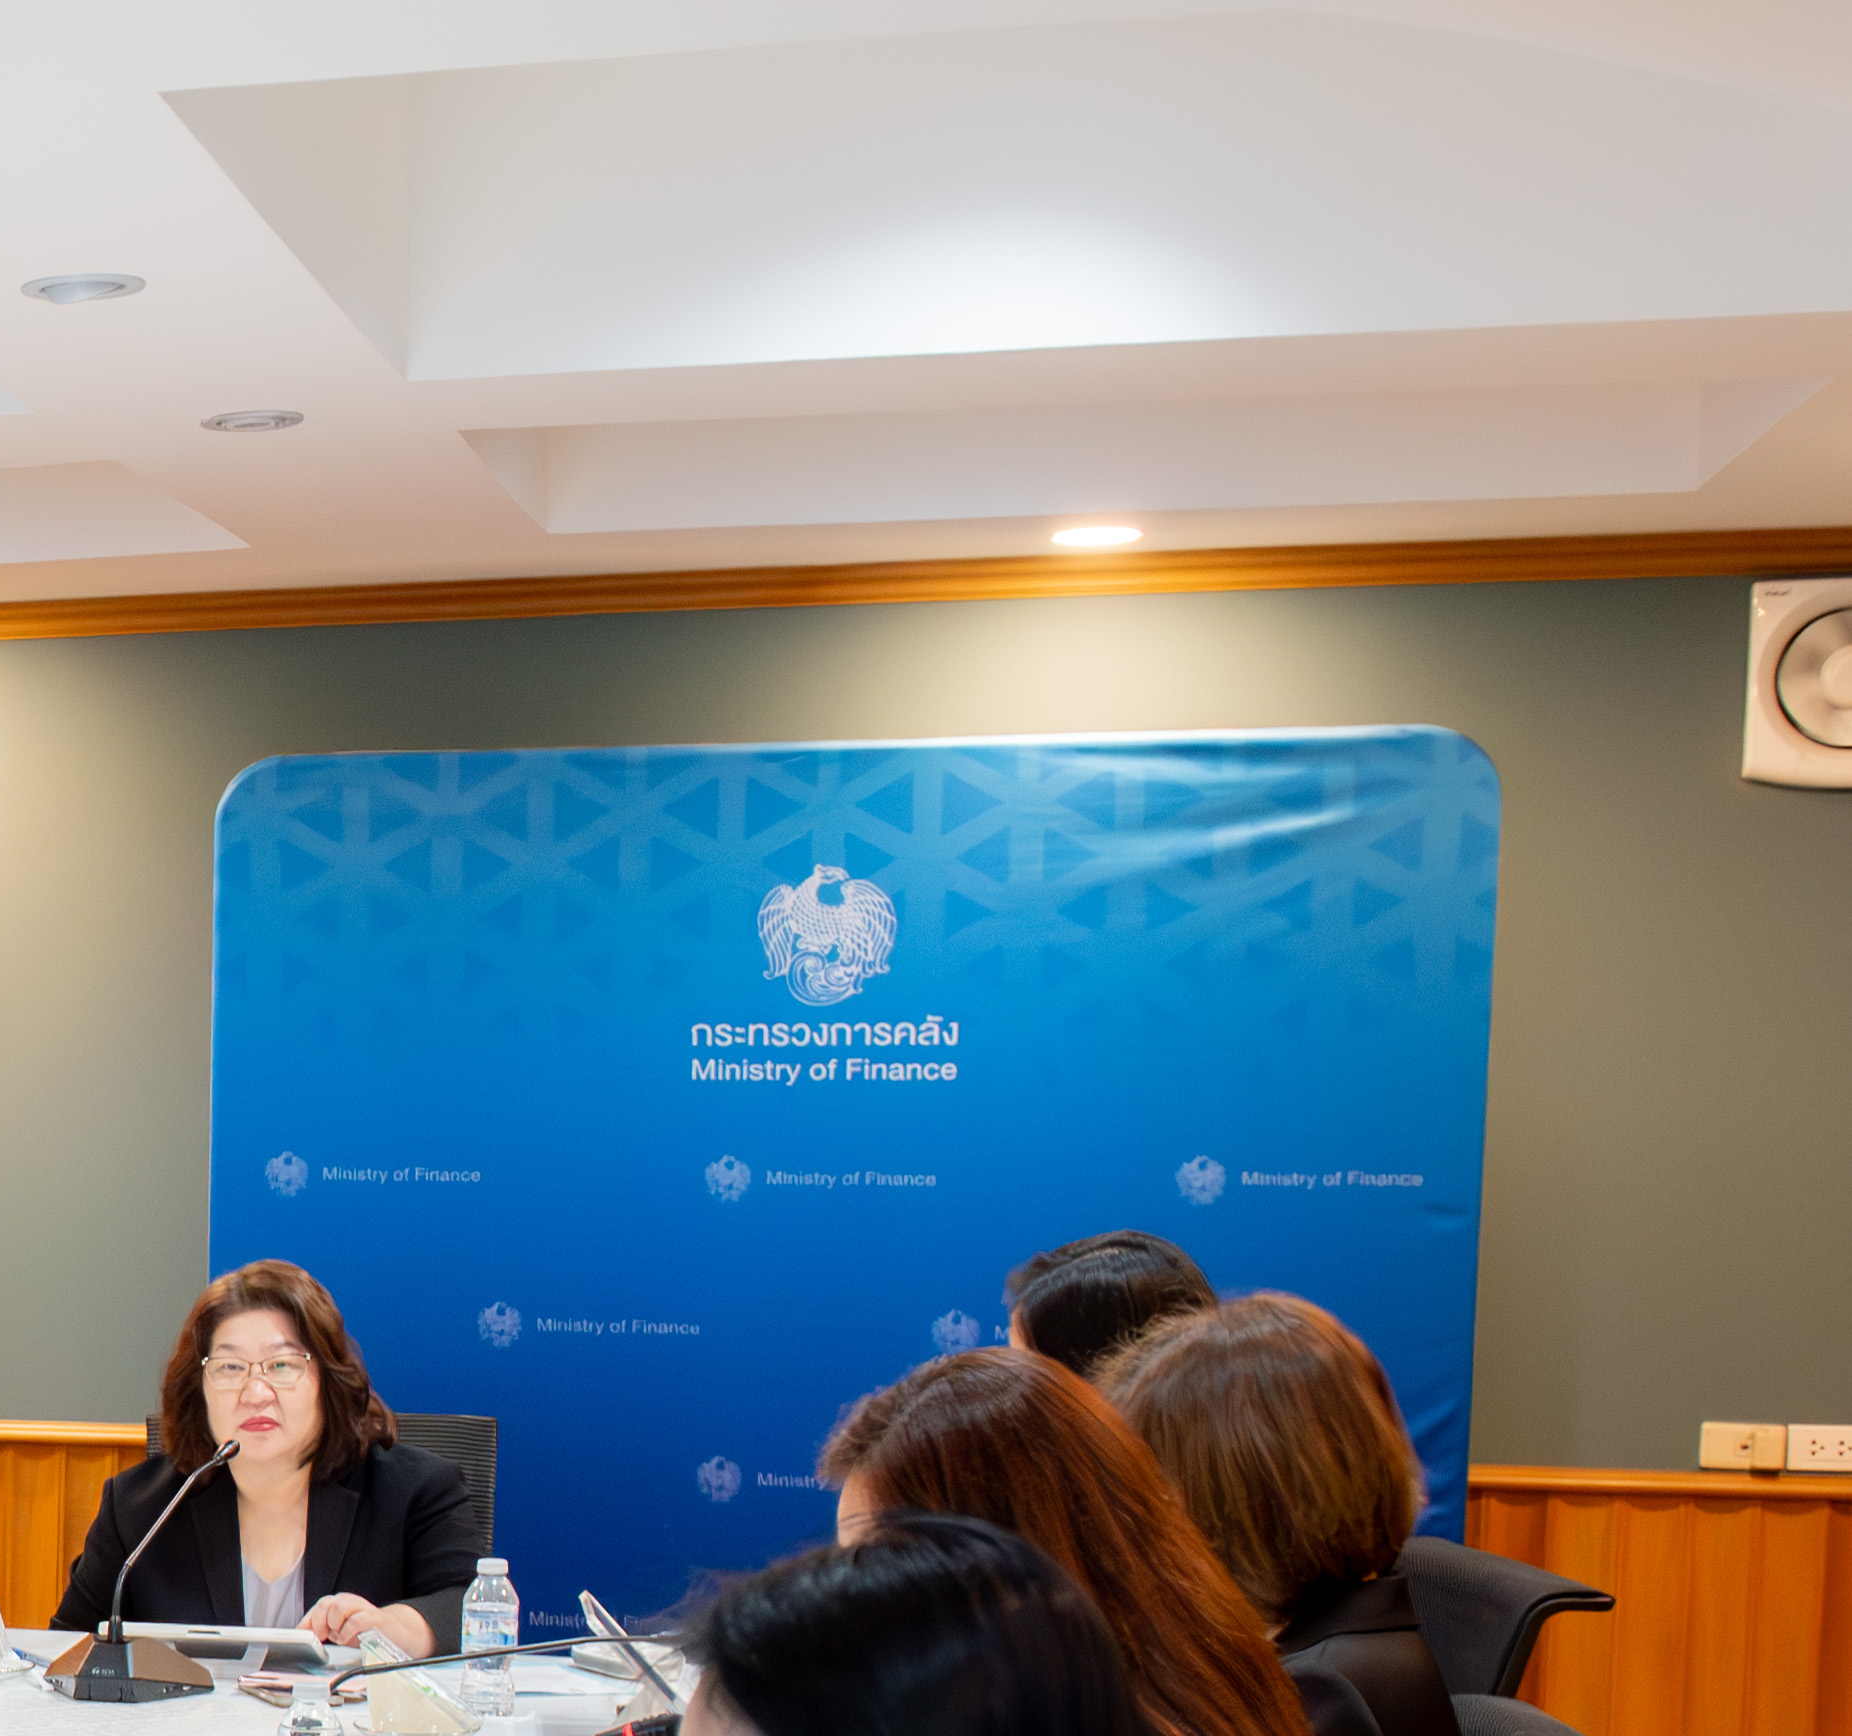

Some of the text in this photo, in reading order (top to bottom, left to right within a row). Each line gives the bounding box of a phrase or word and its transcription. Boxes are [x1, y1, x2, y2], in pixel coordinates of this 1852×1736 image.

[690, 1014, 959, 1047] กระทรวงการคลัง
[691, 1058, 958, 1086] Ministry of Finance
[322, 1166, 481, 1185] Ministry of Finance
[766, 1170, 937, 1190] Ministry of Finance
[1241, 1171, 1424, 1190] Ministry of Finance
[536, 1317, 701, 1336] Ministry of Finance
[529, 1610, 588, 1629] Ministr
